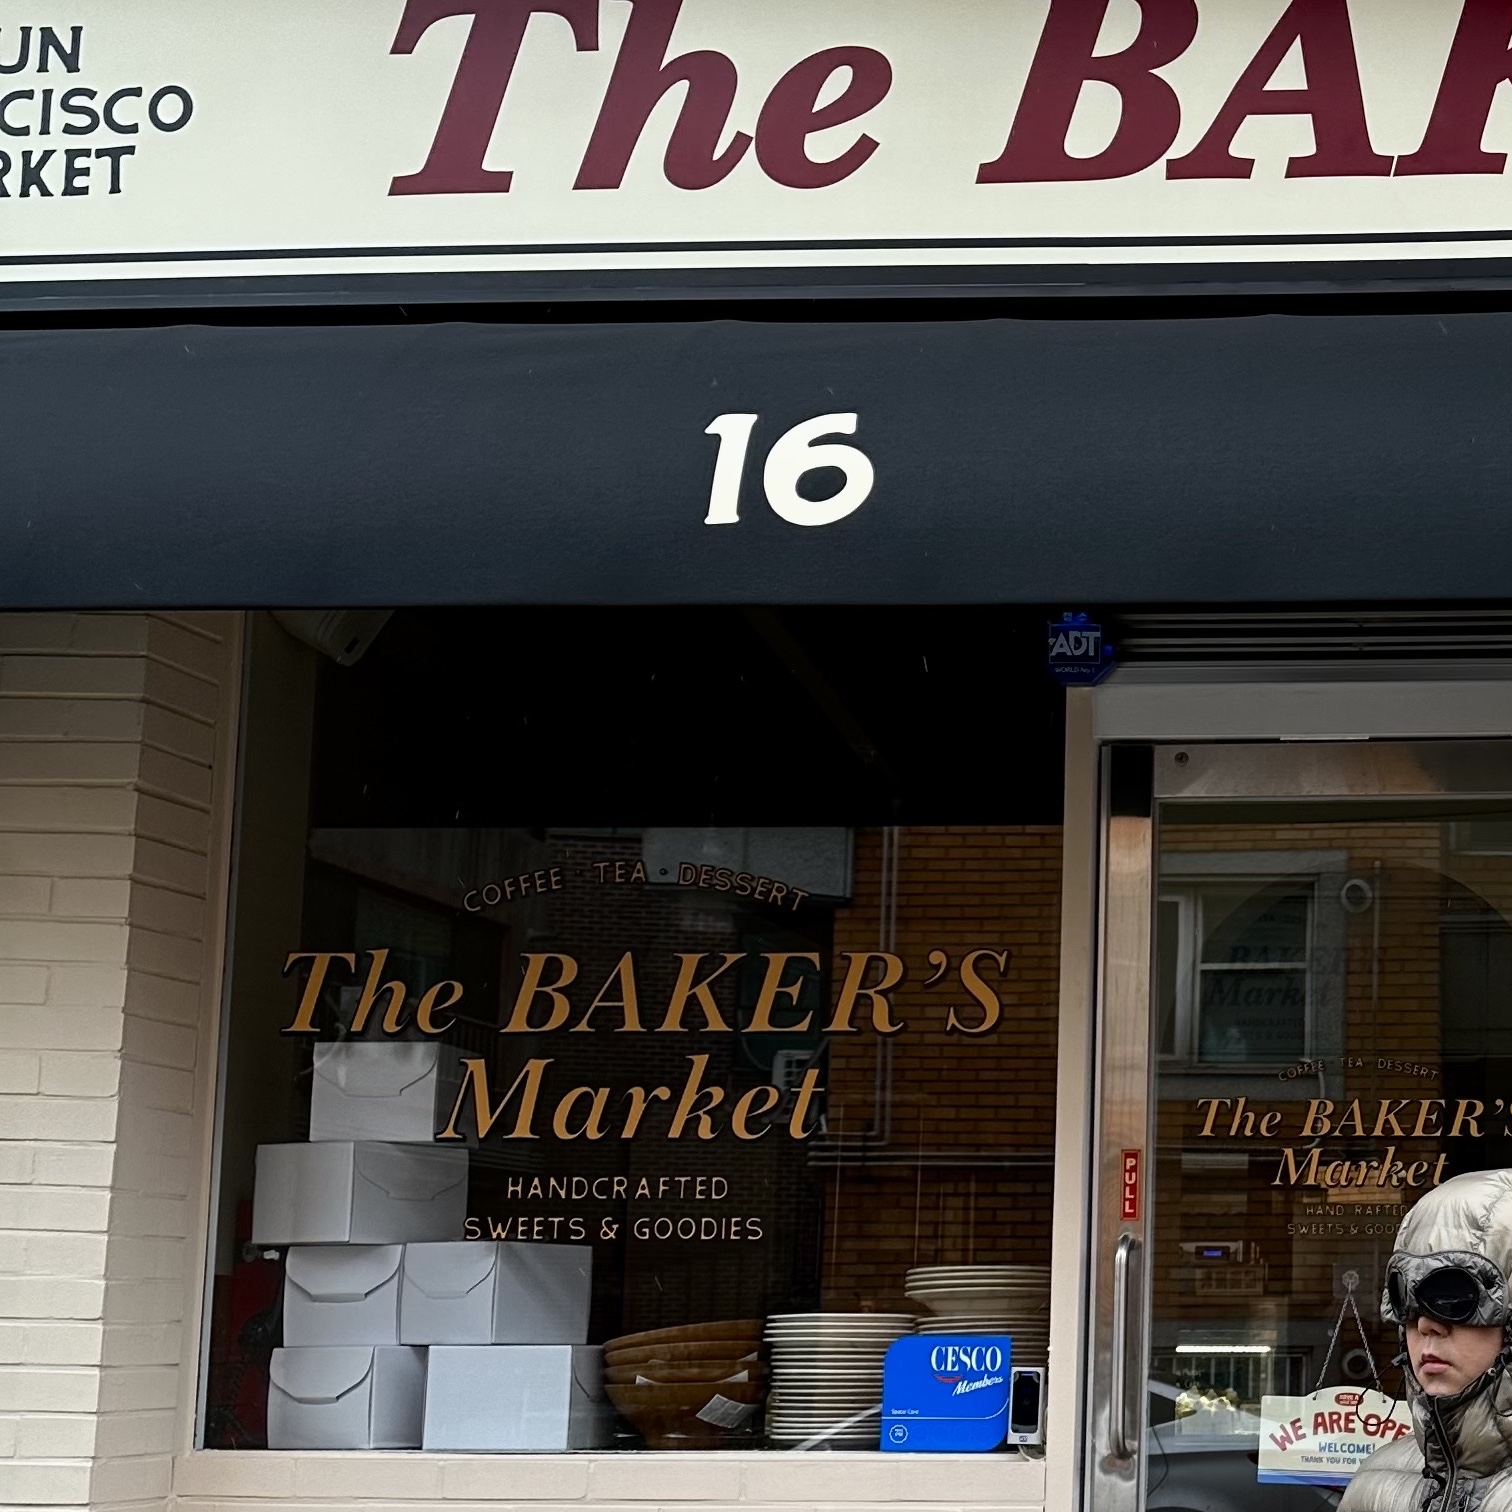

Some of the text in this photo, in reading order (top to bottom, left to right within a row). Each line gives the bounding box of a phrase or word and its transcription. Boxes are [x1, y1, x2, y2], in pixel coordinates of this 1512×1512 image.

[0, 85, 193, 136] CISCO
[388, 0, 893, 196] The
[704, 411, 876, 527] 16
[1050, 630, 1101, 656] ADT
[464, 861, 810, 912] COFFEE TEA DESSERT
[281, 947, 1013, 1036] The BAKER'S
[1278, 1056, 1440, 1082] COFFEE TEA DESSERT
[434, 1053, 827, 1142] Market
[1196, 1096, 1282, 1137] The
[1124, 1157, 1137, 1213] PULL
[1270, 1146, 1450, 1188] Market
[507, 1176, 729, 1200] HANDCRAFTED
[465, 1217, 764, 1241] SWEETS & GOODIES
[1287, 1223, 1344, 1236] SWEETS
[1350, 1223, 1360, 1236] &
[930, 1345, 1002, 1372] CESCO
[951, 1373, 1004, 1397] Members
[1269, 1417, 1307, 1452] WE
[1312, 1411, 1357, 1436] ARE
[1318, 1441, 1376, 1455] WELCOME!
[1301, 1455, 1323, 1464] THANK
[1326, 1456, 1341, 1465] YOU
[1343, 1457, 1357, 1466] FOR
